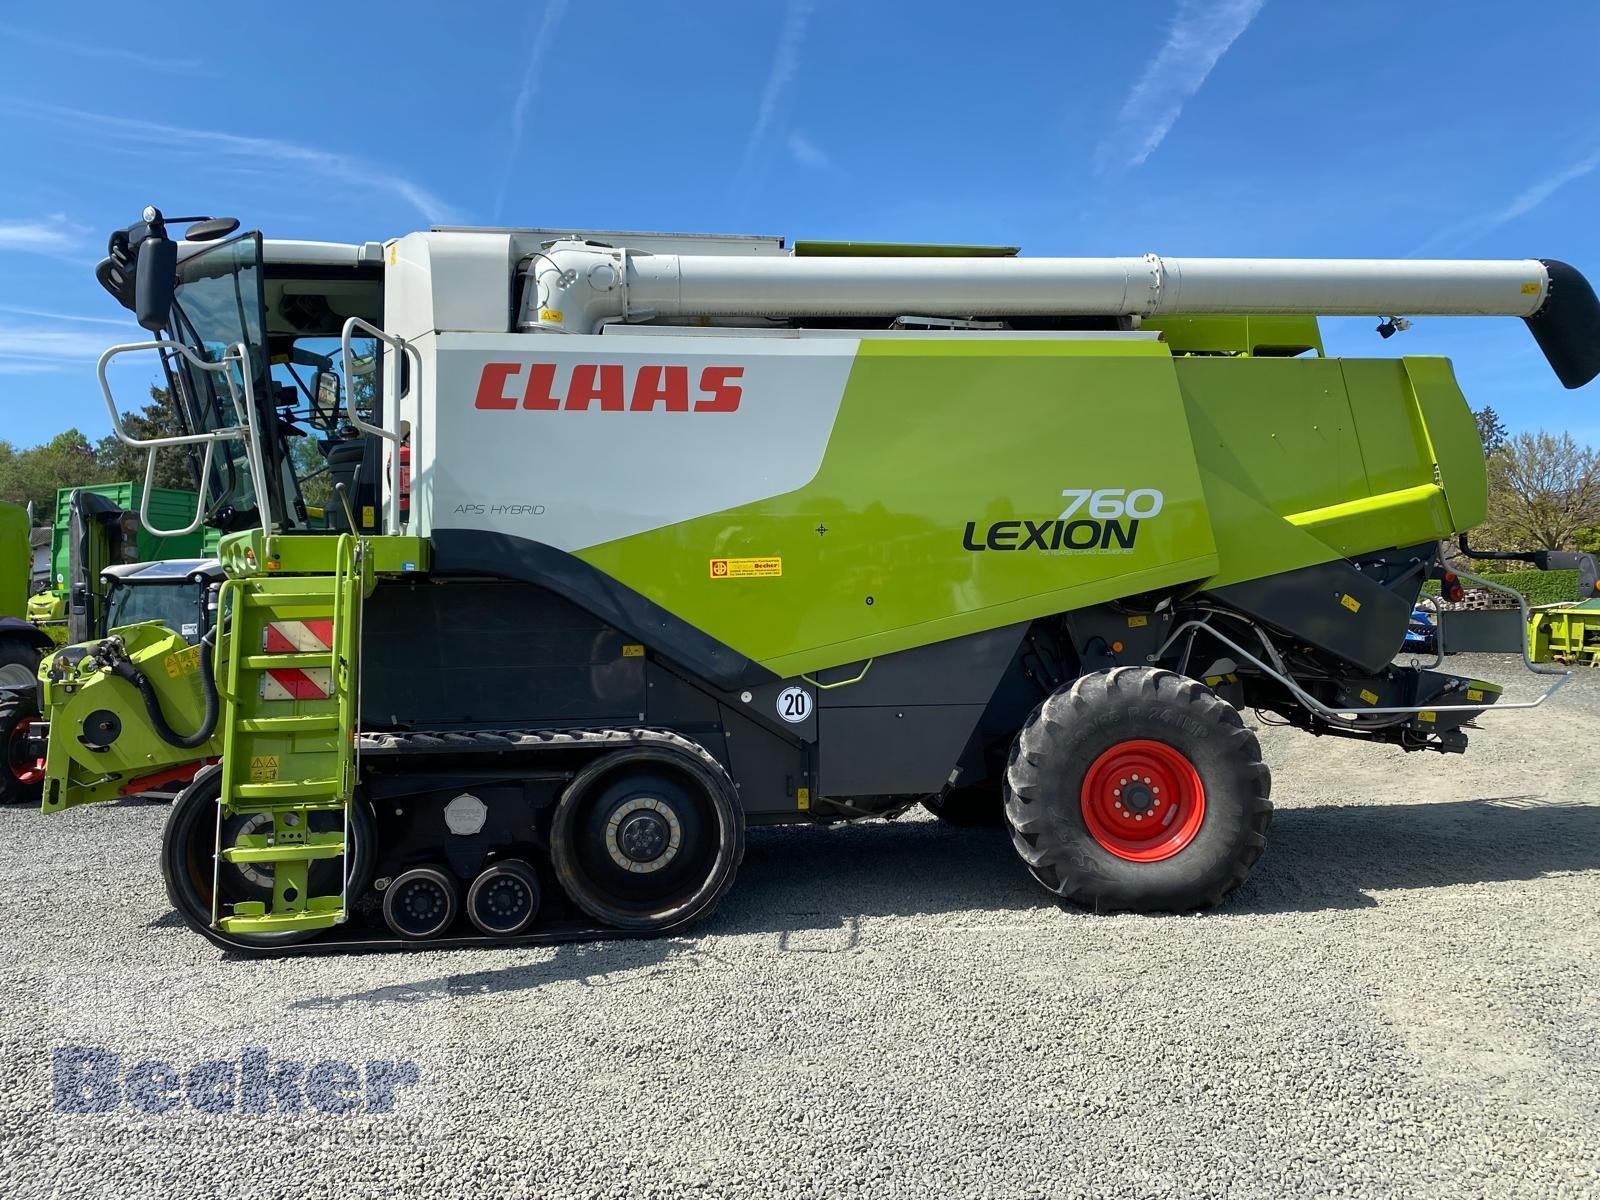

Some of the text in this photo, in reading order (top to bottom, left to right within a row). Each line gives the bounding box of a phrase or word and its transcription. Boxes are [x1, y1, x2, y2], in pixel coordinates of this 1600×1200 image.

[474, 362, 745, 413] CLAAS
[453, 504, 546, 515] APS HYBRID
[1058, 488, 1164, 520] 760
[962, 519, 1140, 552] LEXION
[784, 693, 805, 716] 20
